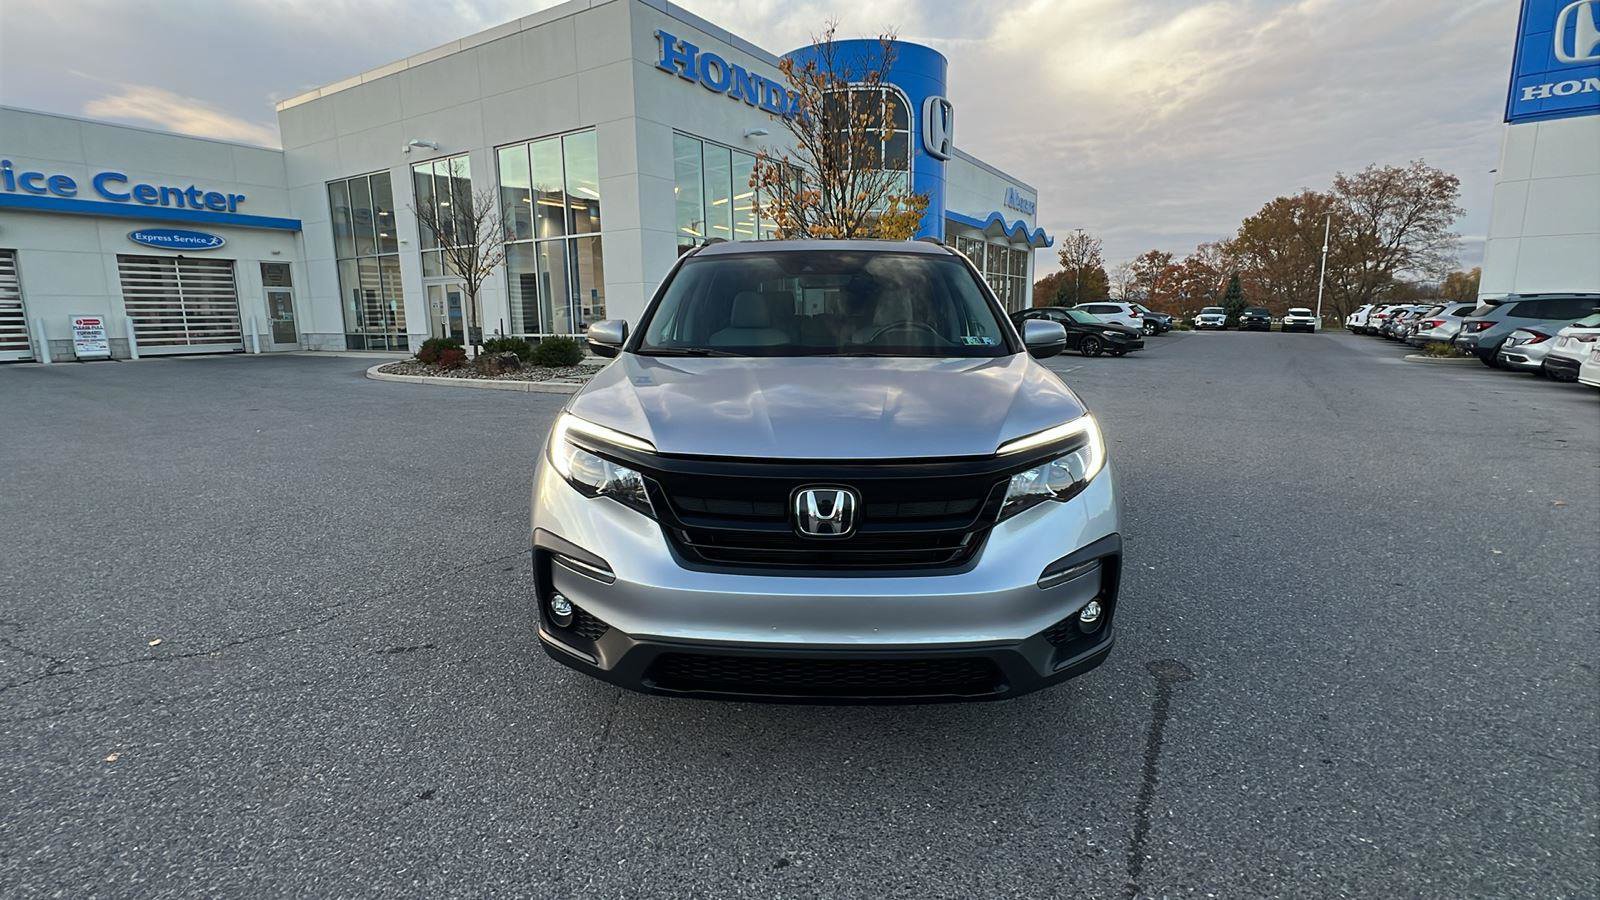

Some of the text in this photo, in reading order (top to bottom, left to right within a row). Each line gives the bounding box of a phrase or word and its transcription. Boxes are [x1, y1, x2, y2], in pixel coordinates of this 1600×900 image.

[0, 159, 246, 212] ice Center
[135, 232, 207, 243] Express Service
